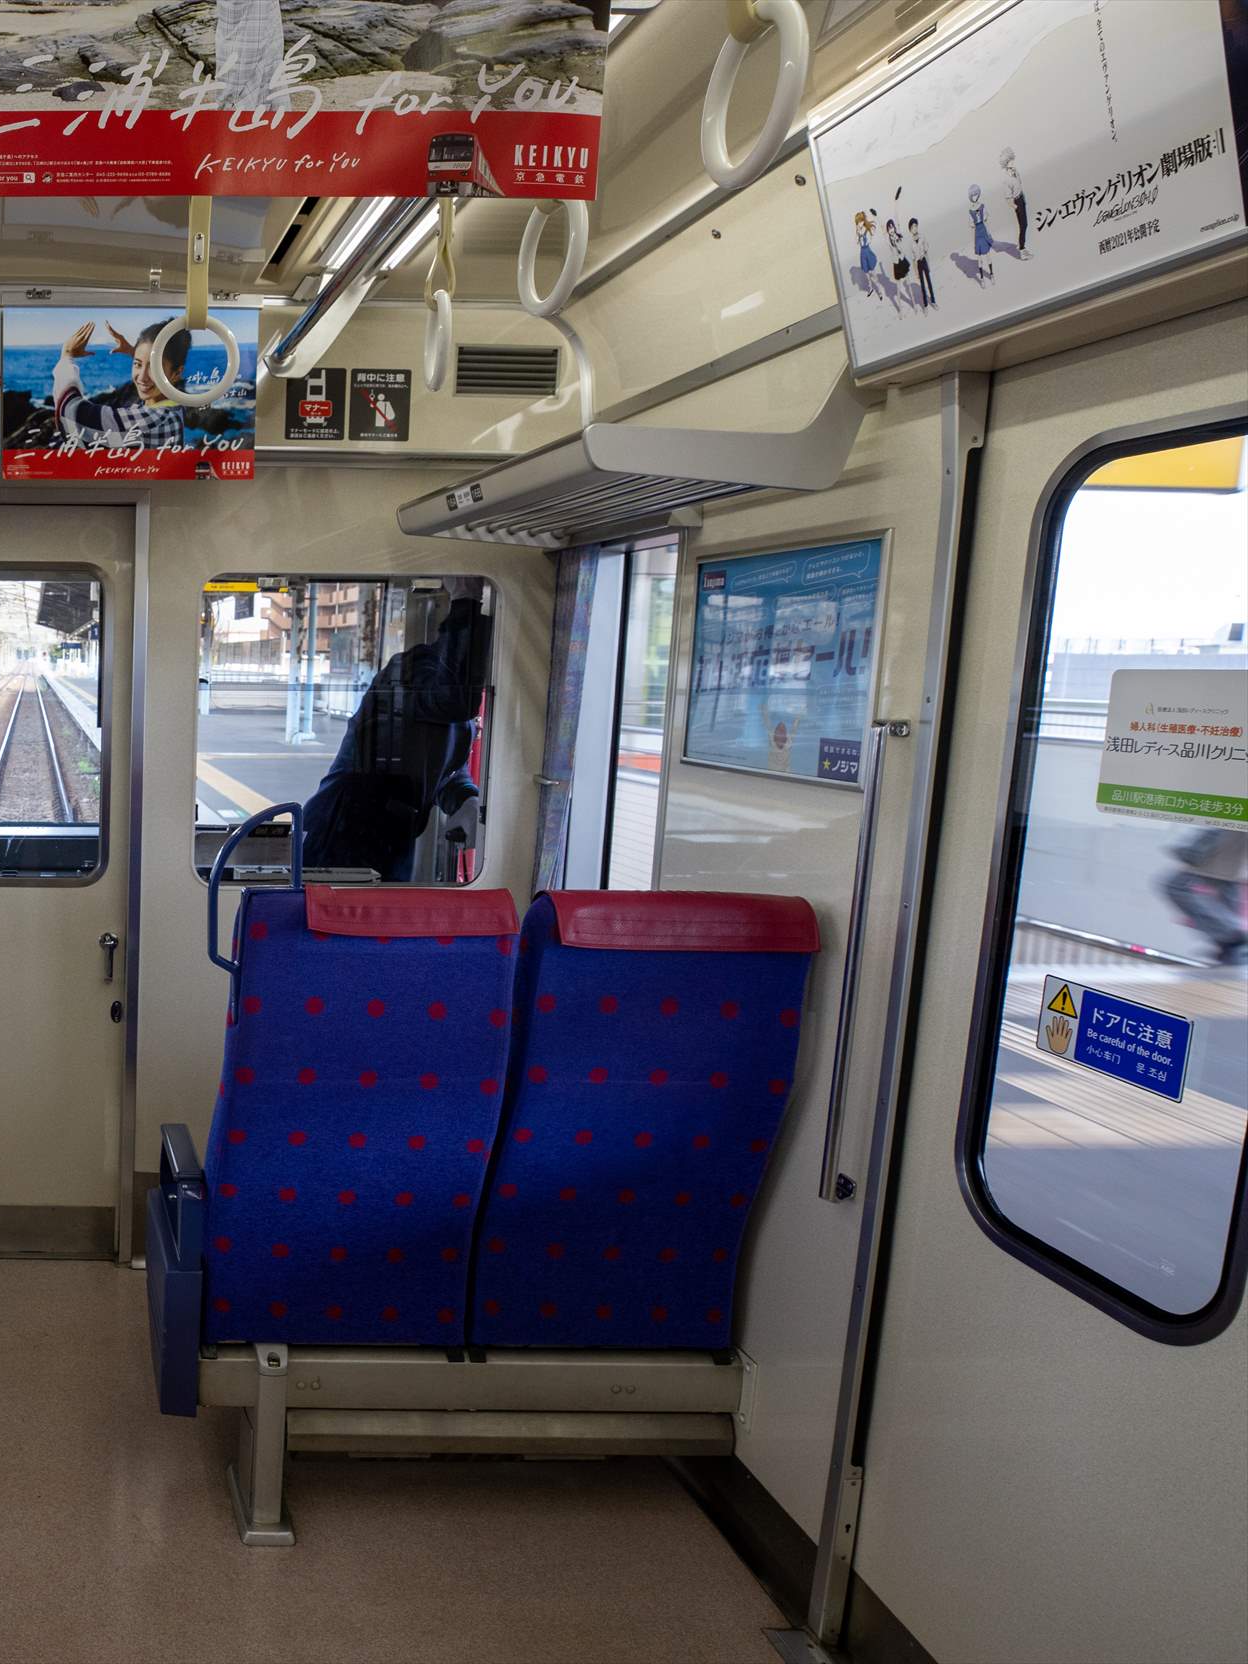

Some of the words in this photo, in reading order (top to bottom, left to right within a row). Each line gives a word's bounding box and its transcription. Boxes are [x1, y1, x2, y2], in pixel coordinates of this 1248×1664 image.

[356, 75, 454, 135] for
[194, 153, 287, 179] KEIKYU
[294, 154, 324, 173] for
[514, 145, 589, 168] KEIKYU
[6, 175, 18, 183] you
[515, 171, 585, 185] 京急電鉄
[1098, 218, 1160, 254] 西暦2021年公開予定
[357, 373, 405, 382] 背中に注意
[14, 425, 144, 461] 三浦半島
[157, 435, 194, 460] for
[222, 461, 250, 470] KEIKYU
[1106, 735, 1248, 763] 浅田レディース品川クリニ
[831, 760, 858, 774] ノジマ
[1092, 1008, 1173, 1050] ドアに注意
[1086, 1044, 1120, 1065] 小心车门
[1087, 1028, 1098, 1039] Be
[1099, 1033, 1125, 1049] careful
[1127, 1043, 1136, 1052] of
[1137, 1046, 1150, 1058] the
[1152, 1052, 1173, 1067] door.
[1136, 1062, 1146, 1074] 문
[1148, 1068, 1167, 1082] 조심
